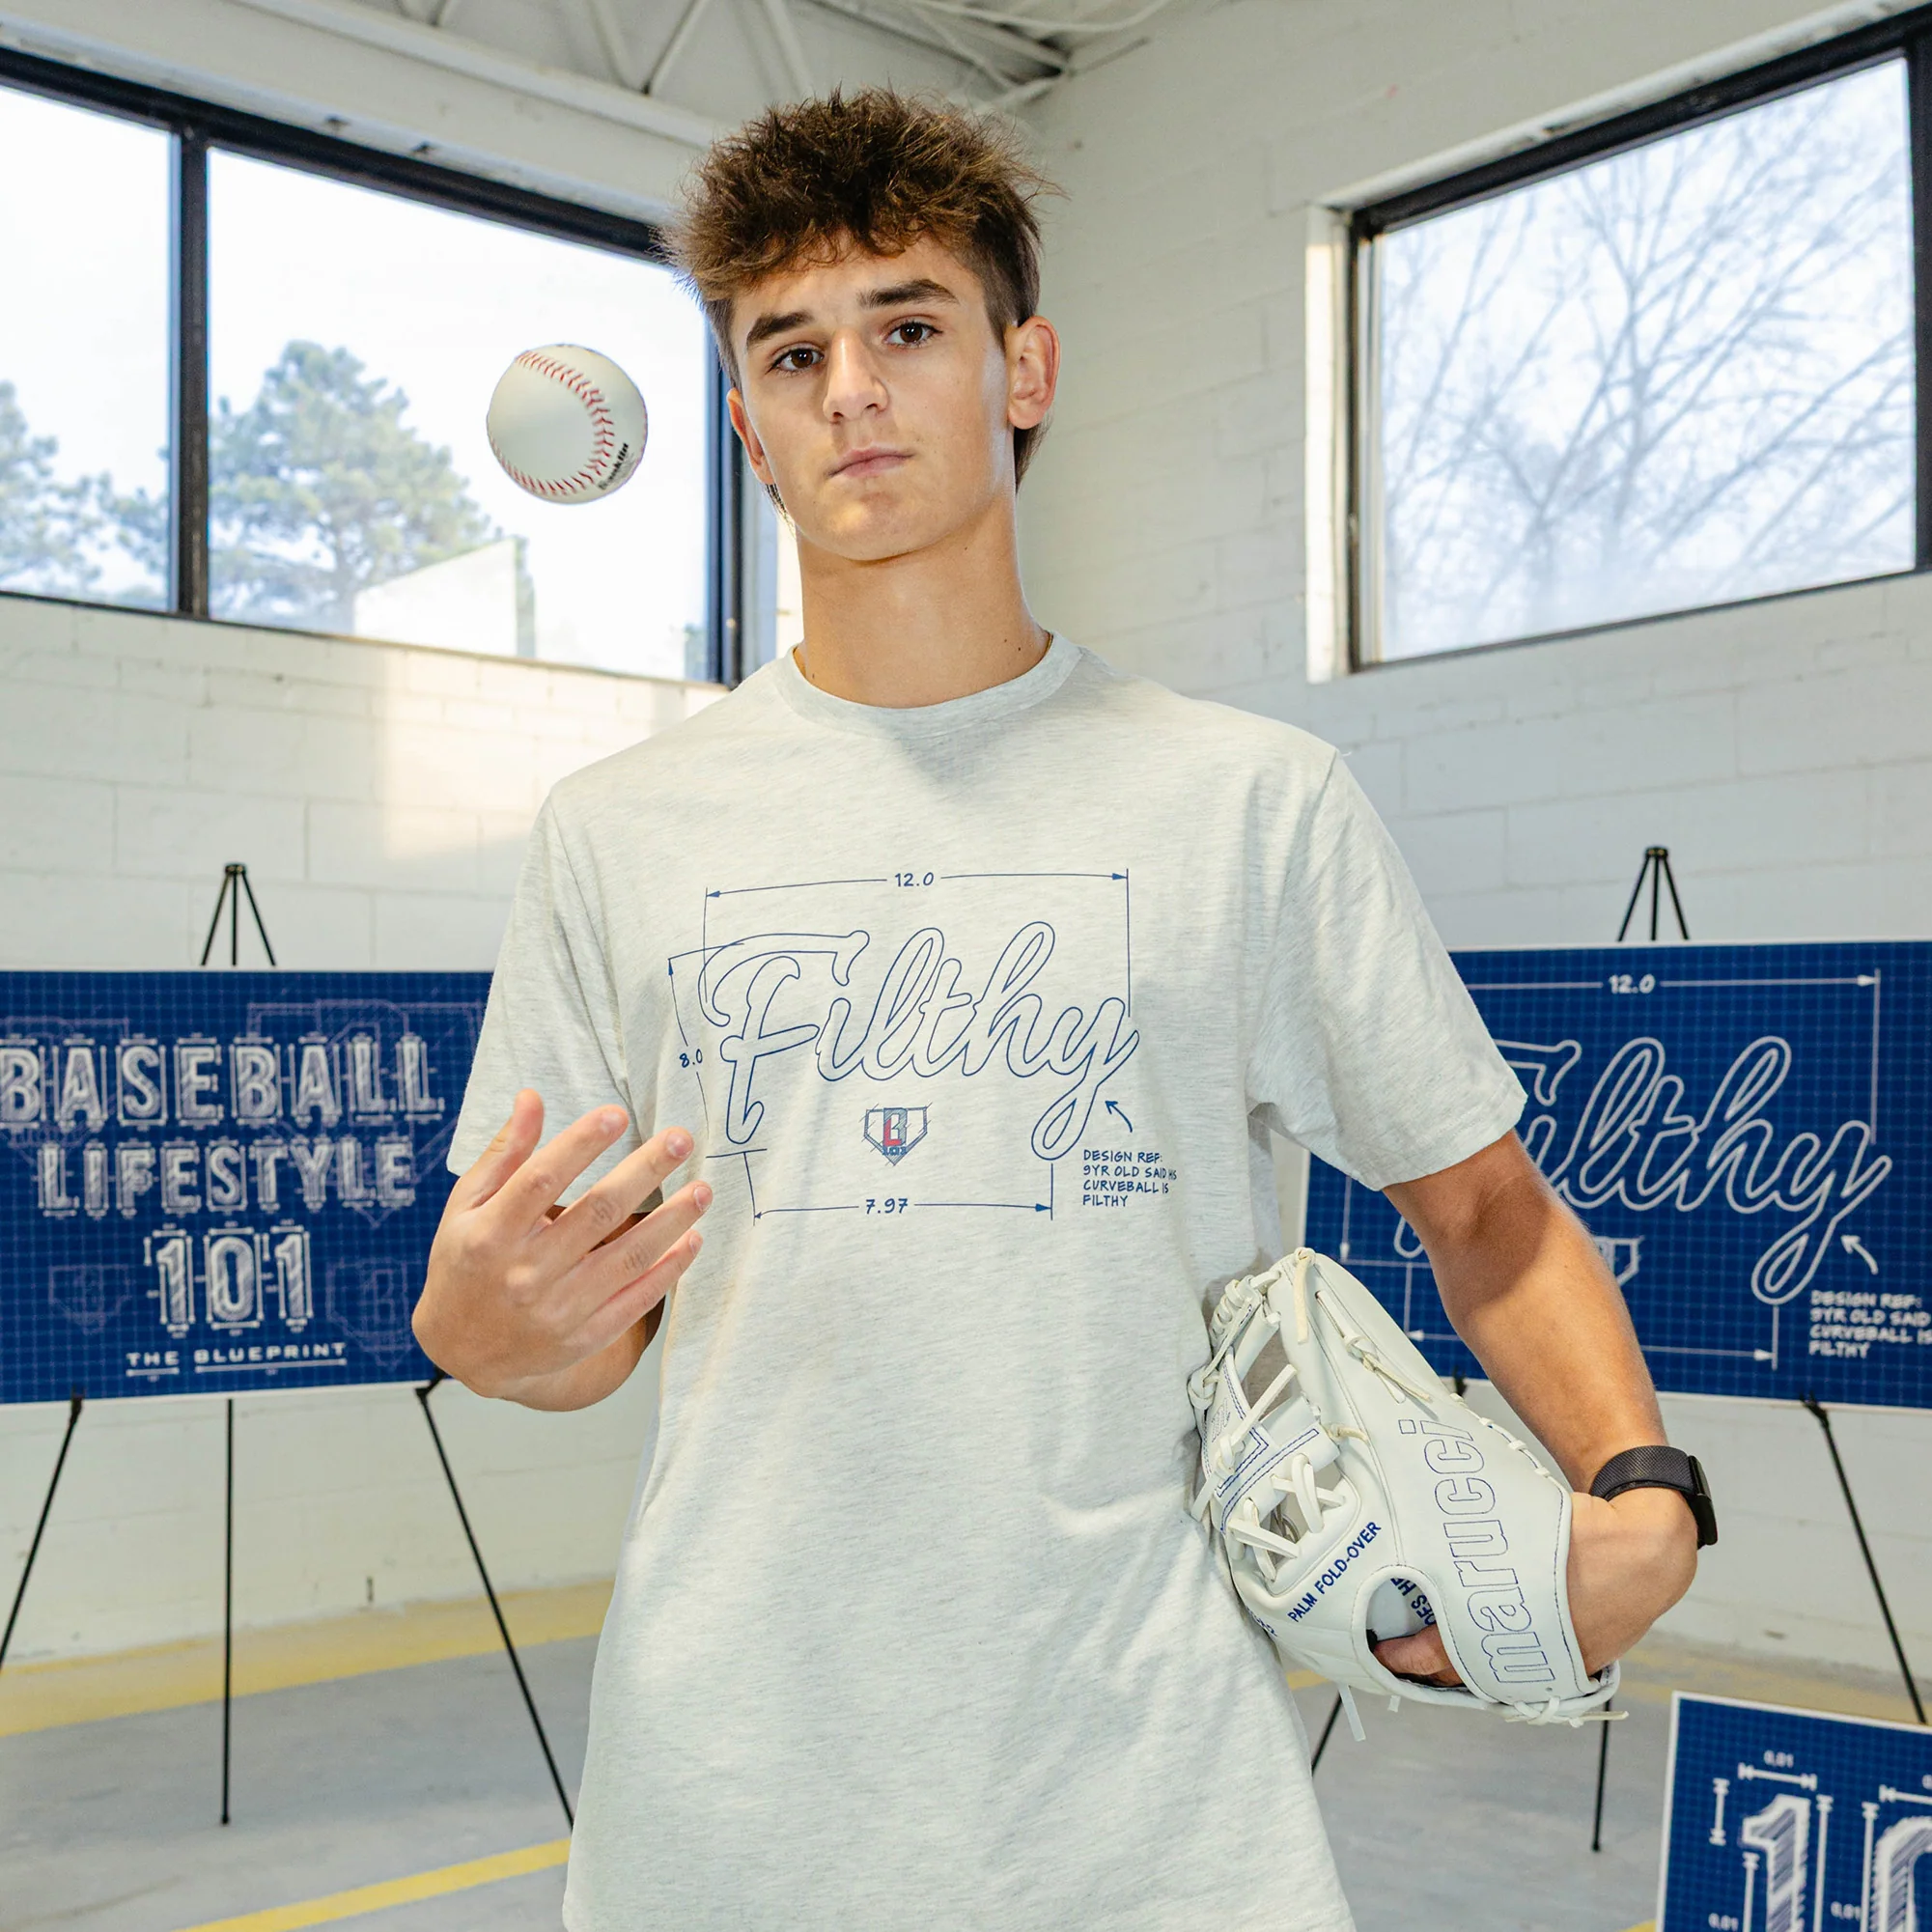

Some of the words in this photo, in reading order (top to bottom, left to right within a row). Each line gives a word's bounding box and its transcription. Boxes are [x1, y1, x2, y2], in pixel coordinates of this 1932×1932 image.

[894, 872, 935, 888] 12.0
[1609, 974, 1656, 994] 12.0
[698, 921, 1140, 1162] Filthy
[679, 1049, 704, 1069] 8.0
[0, 1041, 444, 1122] BASEBALL
[1083, 1149, 1133, 1162] DESIGN
[42, 1143, 416, 1214] LIFESTYLE
[1083, 1164, 1110, 1176] 9YR
[1113, 1165, 1140, 1177] OLD
[1144, 1167, 1166, 1179] SAID
[1492, 1036, 1892, 1303] ilthy
[1083, 1179, 1160, 1192] CURVEBALL
[1162, 1183, 1169, 1193] IS
[864, 1197, 910, 1215] 7.97
[1082, 1194, 1129, 1207] FILTHY
[155, 1235, 306, 1323] 101
[1810, 1290, 1877, 1307] DESIGN
[1849, 1308, 1886, 1325] OLD
[1890, 1310, 1932, 1328] SAID
[1809, 1324, 1914, 1344] CURVEBALL
[126, 1352, 179, 1366] THE
[194, 1342, 346, 1363] BLUEPRINT
[1808, 1340, 1870, 1358] FILTHY
[1398, 1417, 1555, 1684] marucci
[1287, 1593, 1317, 1623] PALM
[1314, 1521, 1383, 1594] FOLD-OVER
